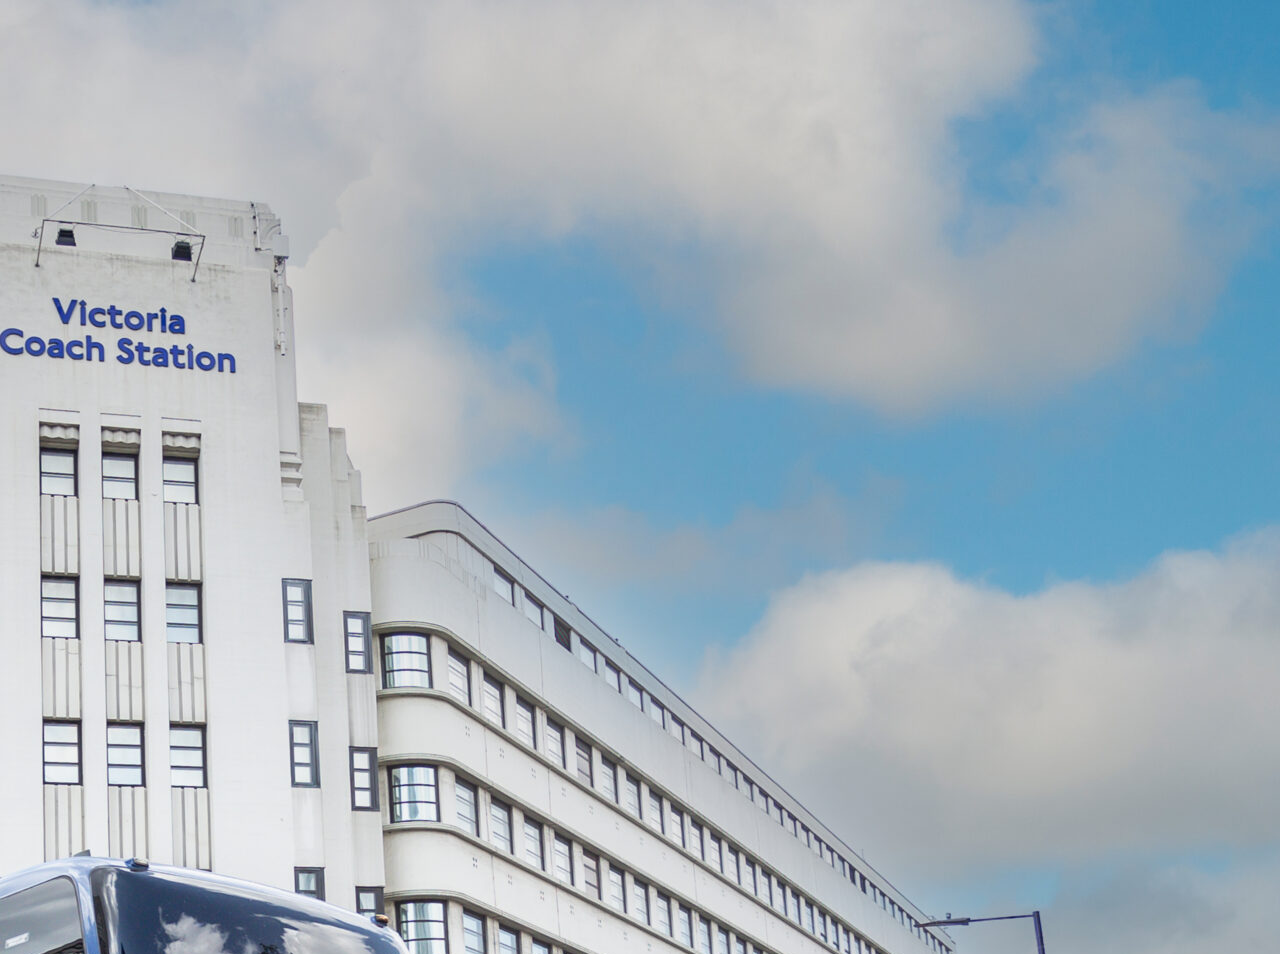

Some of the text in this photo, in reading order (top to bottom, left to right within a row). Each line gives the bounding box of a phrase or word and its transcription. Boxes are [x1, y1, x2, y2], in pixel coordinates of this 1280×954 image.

[52, 297, 186, 334] Victoria
[0, 328, 236, 373] Coach Station
